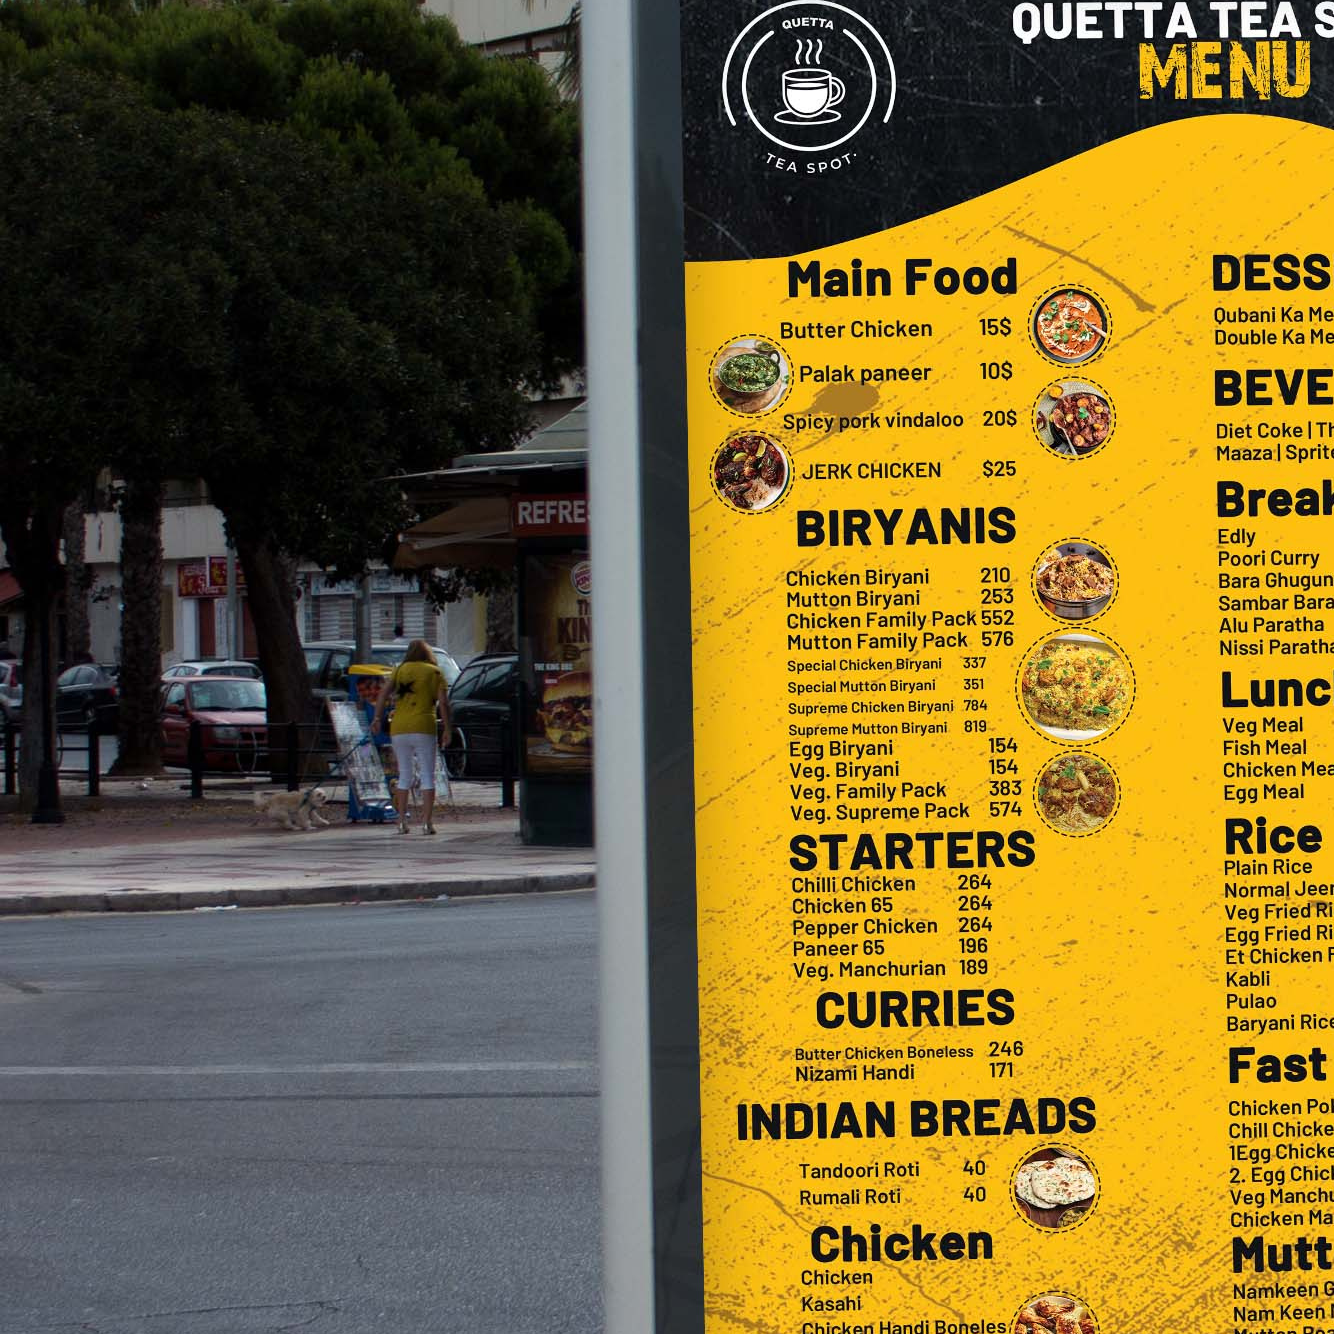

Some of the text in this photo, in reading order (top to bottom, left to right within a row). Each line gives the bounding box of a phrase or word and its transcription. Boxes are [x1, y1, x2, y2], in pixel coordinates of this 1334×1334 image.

[782, 17, 835, 30] QUETTA
[1012, 2, 1197, 44] QUETTA
[1211, 2, 1301, 38] TEA
[1139, 40, 1311, 100] MENU
[766, 152, 798, 173] TEA
[789, 258, 1017, 297] Main Food
[1215, 307, 1275, 324] Qubani
[1282, 307, 1303, 322] Ka
[781, 317, 1011, 338] Butter Chicken 15$
[1216, 330, 1276, 345] Double
[1283, 329, 1304, 344] Ka
[801, 361, 1012, 386] Palak paneer 10$
[784, 410, 1016, 433] Spicy pork vindaloo 20$
[803, 460, 1016, 479] JERK CHICKEN $25
[518, 500, 589, 524] REFRE
[797, 507, 1016, 546] BIRYANIS
[1219, 529, 1255, 547] Edly
[787, 568, 1010, 588] Chicken Biryani 210
[1219, 596, 1288, 611] Sambar
[1295, 595, 1334, 609] Bara
[788, 631, 1013, 652] Mutton Family Pack 576
[1220, 640, 1263, 655] Nissi
[788, 657, 986, 674] Special Chicken Biryani 337
[789, 720, 986, 738] Supreme Mutton Biryani 819
[1223, 718, 1256, 736] Veg
[1263, 717, 1302, 732] Meal
[1224, 762, 1296, 777] Chicken
[791, 802, 1022, 824] Veg. Supreme Pack 574
[1226, 817, 1322, 854] Rice
[790, 830, 1035, 871] STARTERS
[1225, 860, 1267, 875] Plain
[1274, 859, 1312, 874] Rice
[792, 875, 991, 893] Chilli Chicken 264
[1225, 905, 1258, 923] Veg
[1265, 903, 1310, 919] Fried
[794, 938, 987, 956] Paneer 65 196
[1226, 950, 1244, 964] Et
[1250, 948, 1322, 964] Chicken
[794, 959, 987, 981] Veg. Manchurian 189
[1227, 971, 1269, 987] Kabli
[817, 989, 1014, 1029] CURRIES
[1227, 994, 1276, 1008] Pulao
[1228, 1015, 1294, 1034] Baryani
[796, 1041, 1023, 1060] Butter Chicken Boneless 246
[1229, 1047, 1326, 1083] Fast
[1229, 1100, 1301, 1116] Chicken
[738, 1097, 1096, 1140] INDIAN BREADS
[800, 1160, 985, 1178] Tandoori Roti 40
[1230, 1168, 1245, 1183] 2.
[1252, 1167, 1284, 1186] Egg
[1231, 1211, 1303, 1227] Chicken
[812, 1224, 992, 1262] Chicken
[802, 1270, 872, 1285] Chicken
[1234, 1283, 1318, 1299] Namkeen
[802, 1296, 860, 1311] Kasahi
